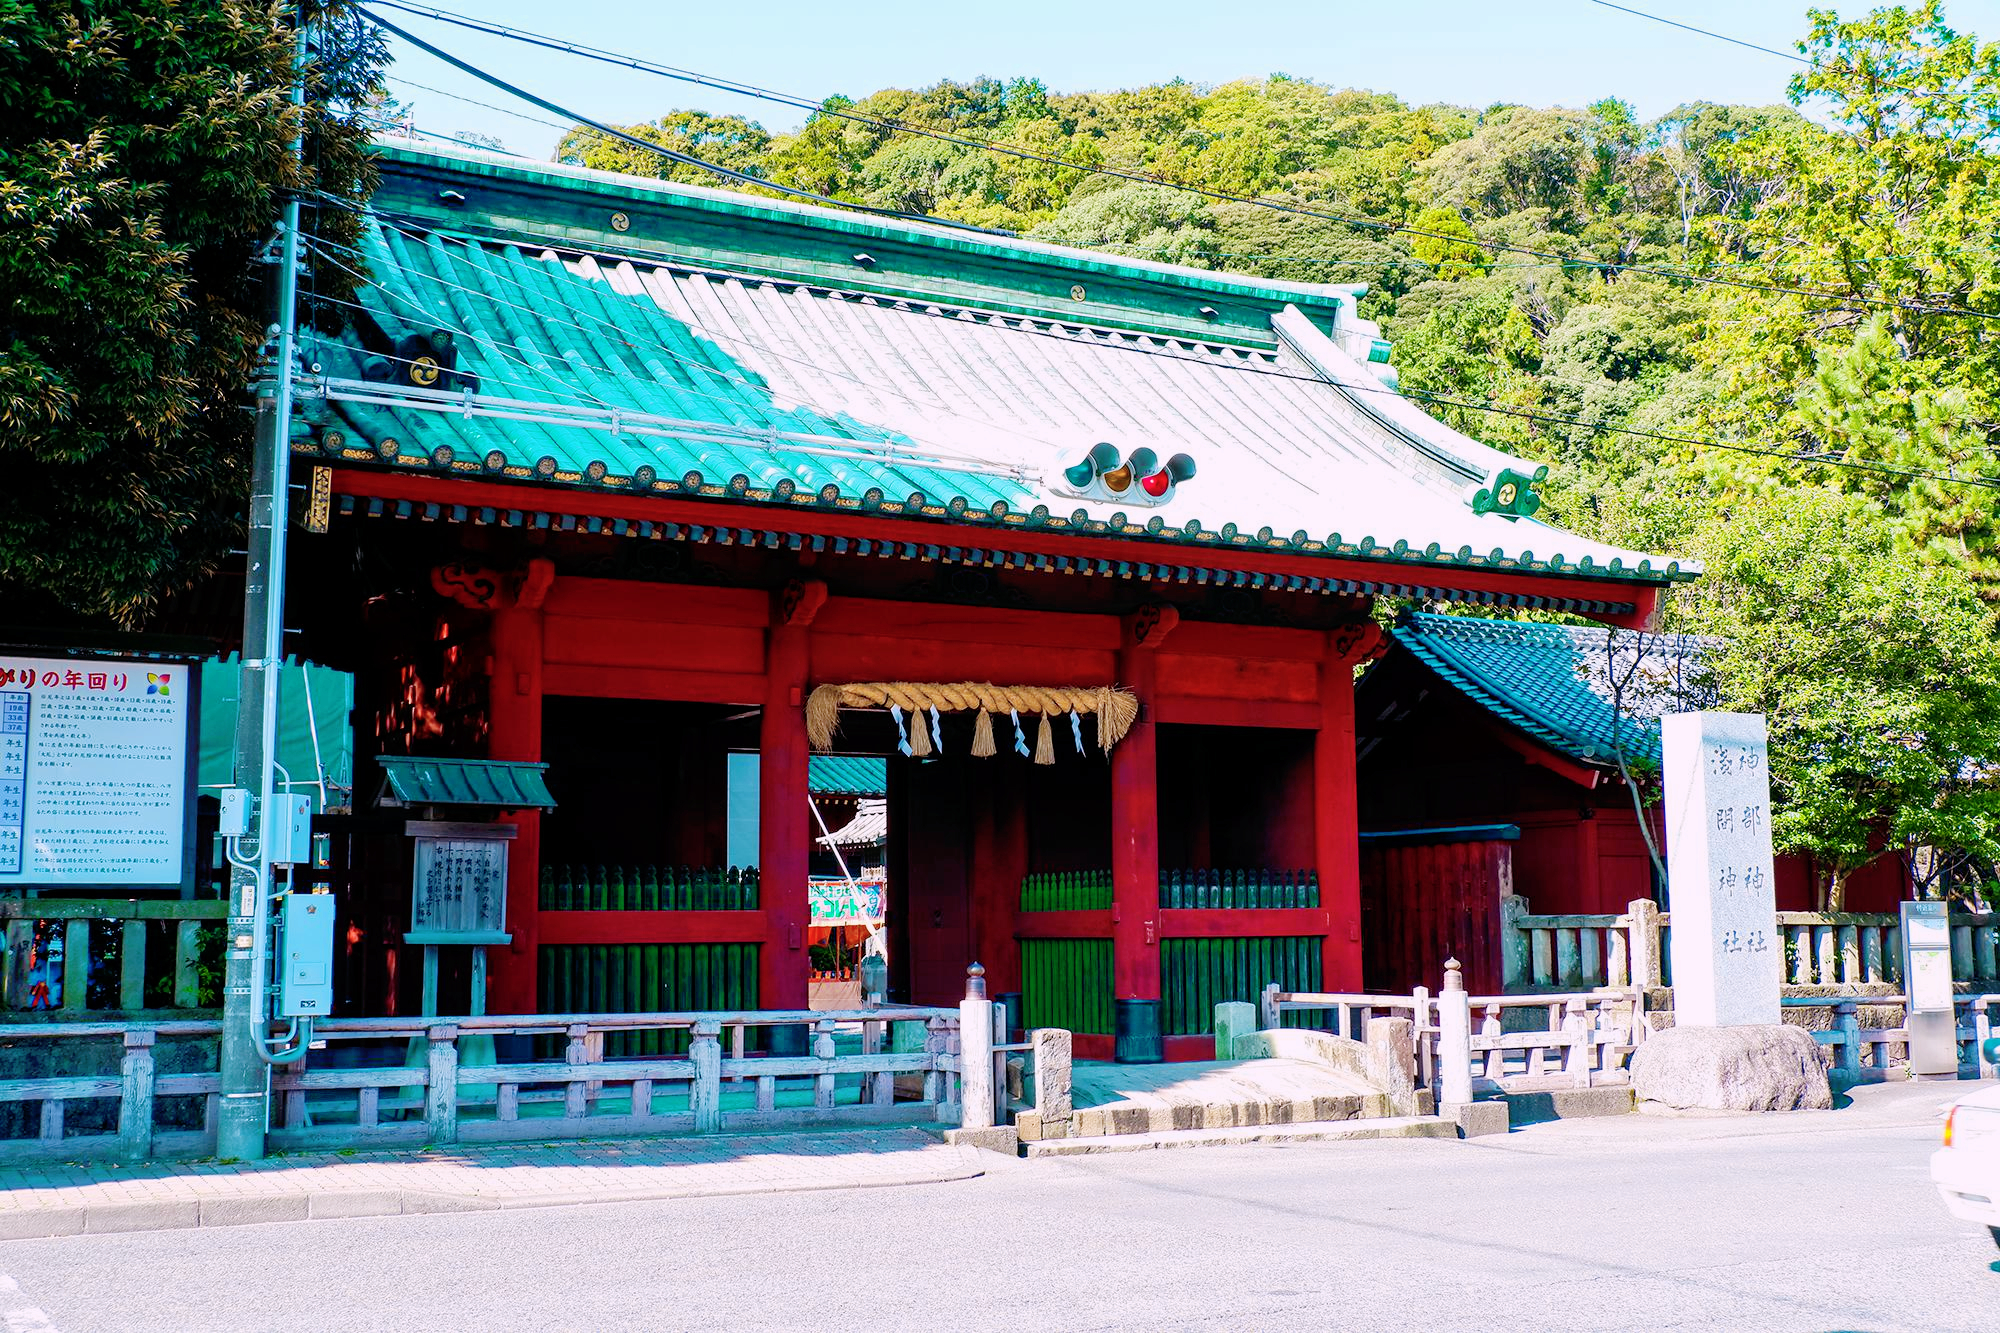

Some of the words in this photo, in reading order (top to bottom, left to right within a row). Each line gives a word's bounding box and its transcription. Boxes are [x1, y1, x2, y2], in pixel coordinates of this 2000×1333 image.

[8, 714, 24, 722] 33歳
[6, 739, 23, 748] 年生
[5, 752, 23, 761] 年生
[4, 765, 22, 774] 年生
[3, 785, 21, 795] 年生
[2, 798, 20, 808] 年生
[2, 812, 19, 821] 年生
[1, 830, 18, 839] 年生
[1739, 745, 1768, 953] 神部神社
